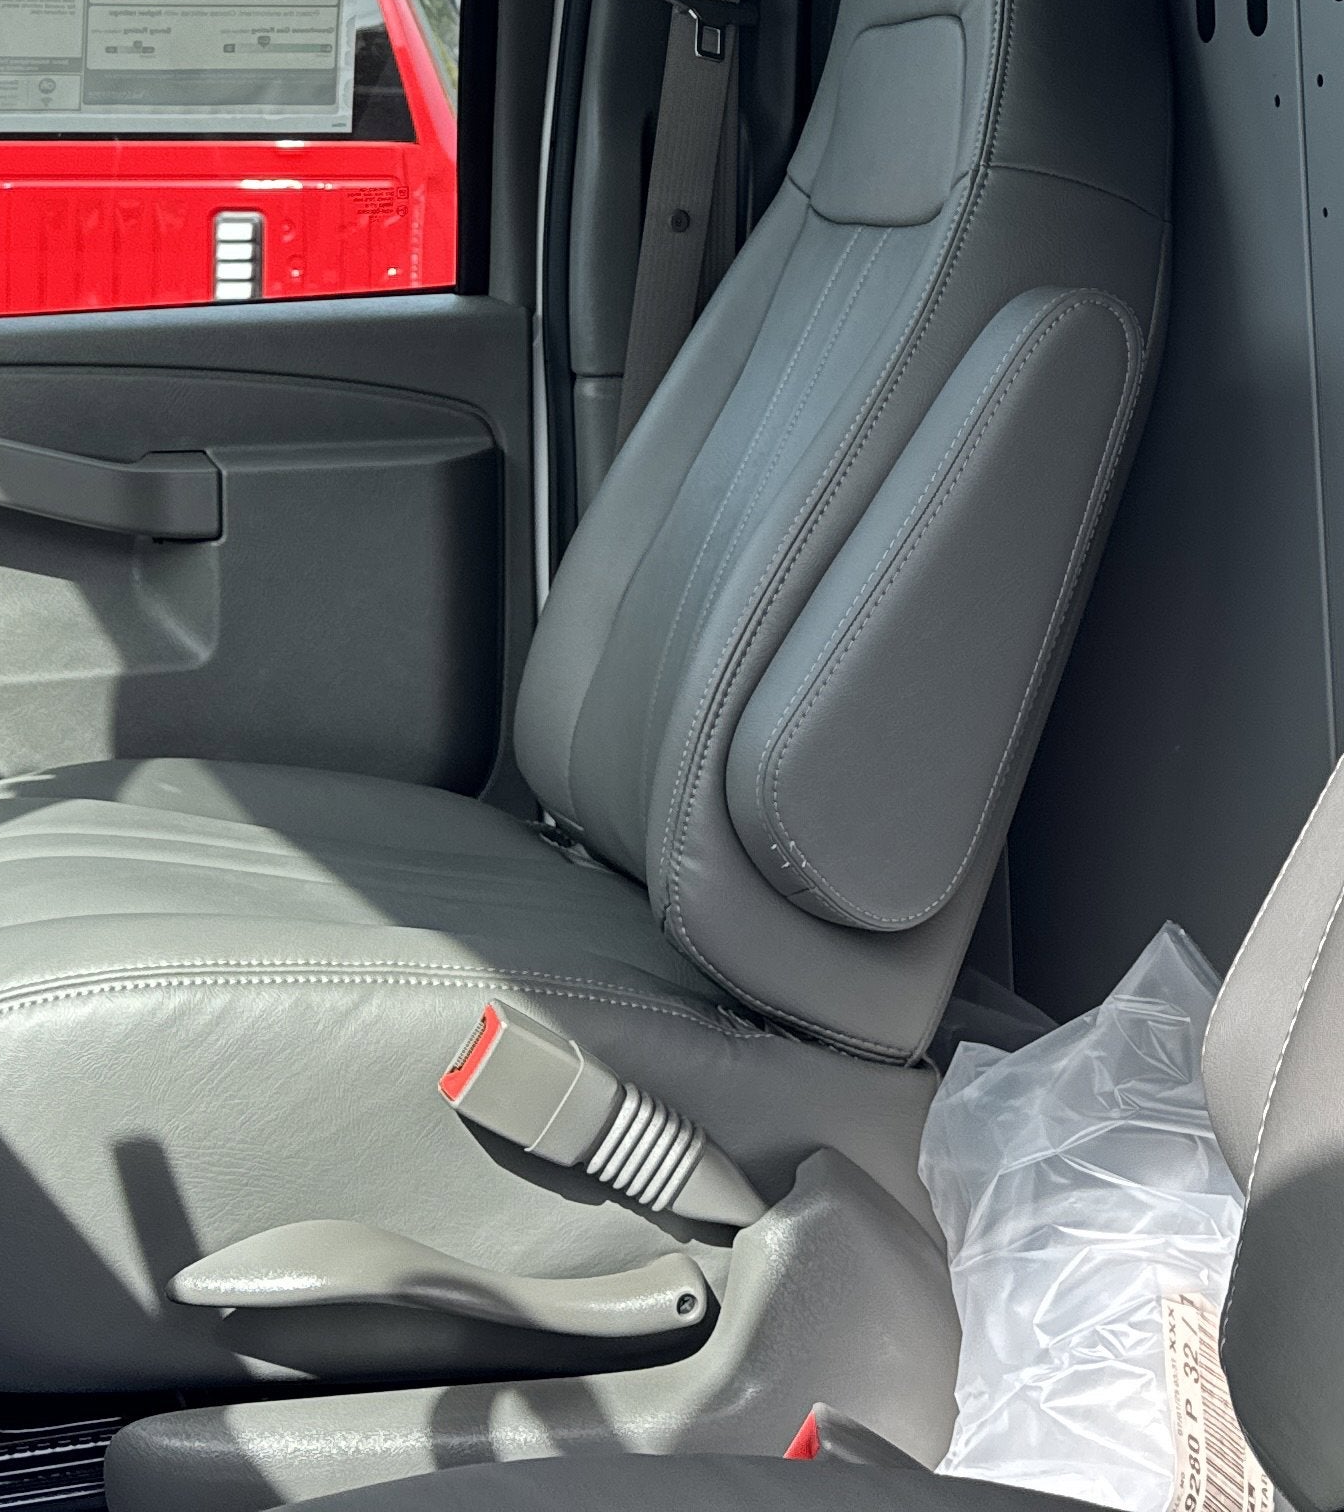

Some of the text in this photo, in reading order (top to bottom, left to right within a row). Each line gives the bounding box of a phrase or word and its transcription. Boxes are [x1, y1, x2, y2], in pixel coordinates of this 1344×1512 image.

[1167, 1305, 1177, 1354] XXX
[1183, 1342, 1200, 1385] 32
[1186, 1398, 1199, 1423] P
